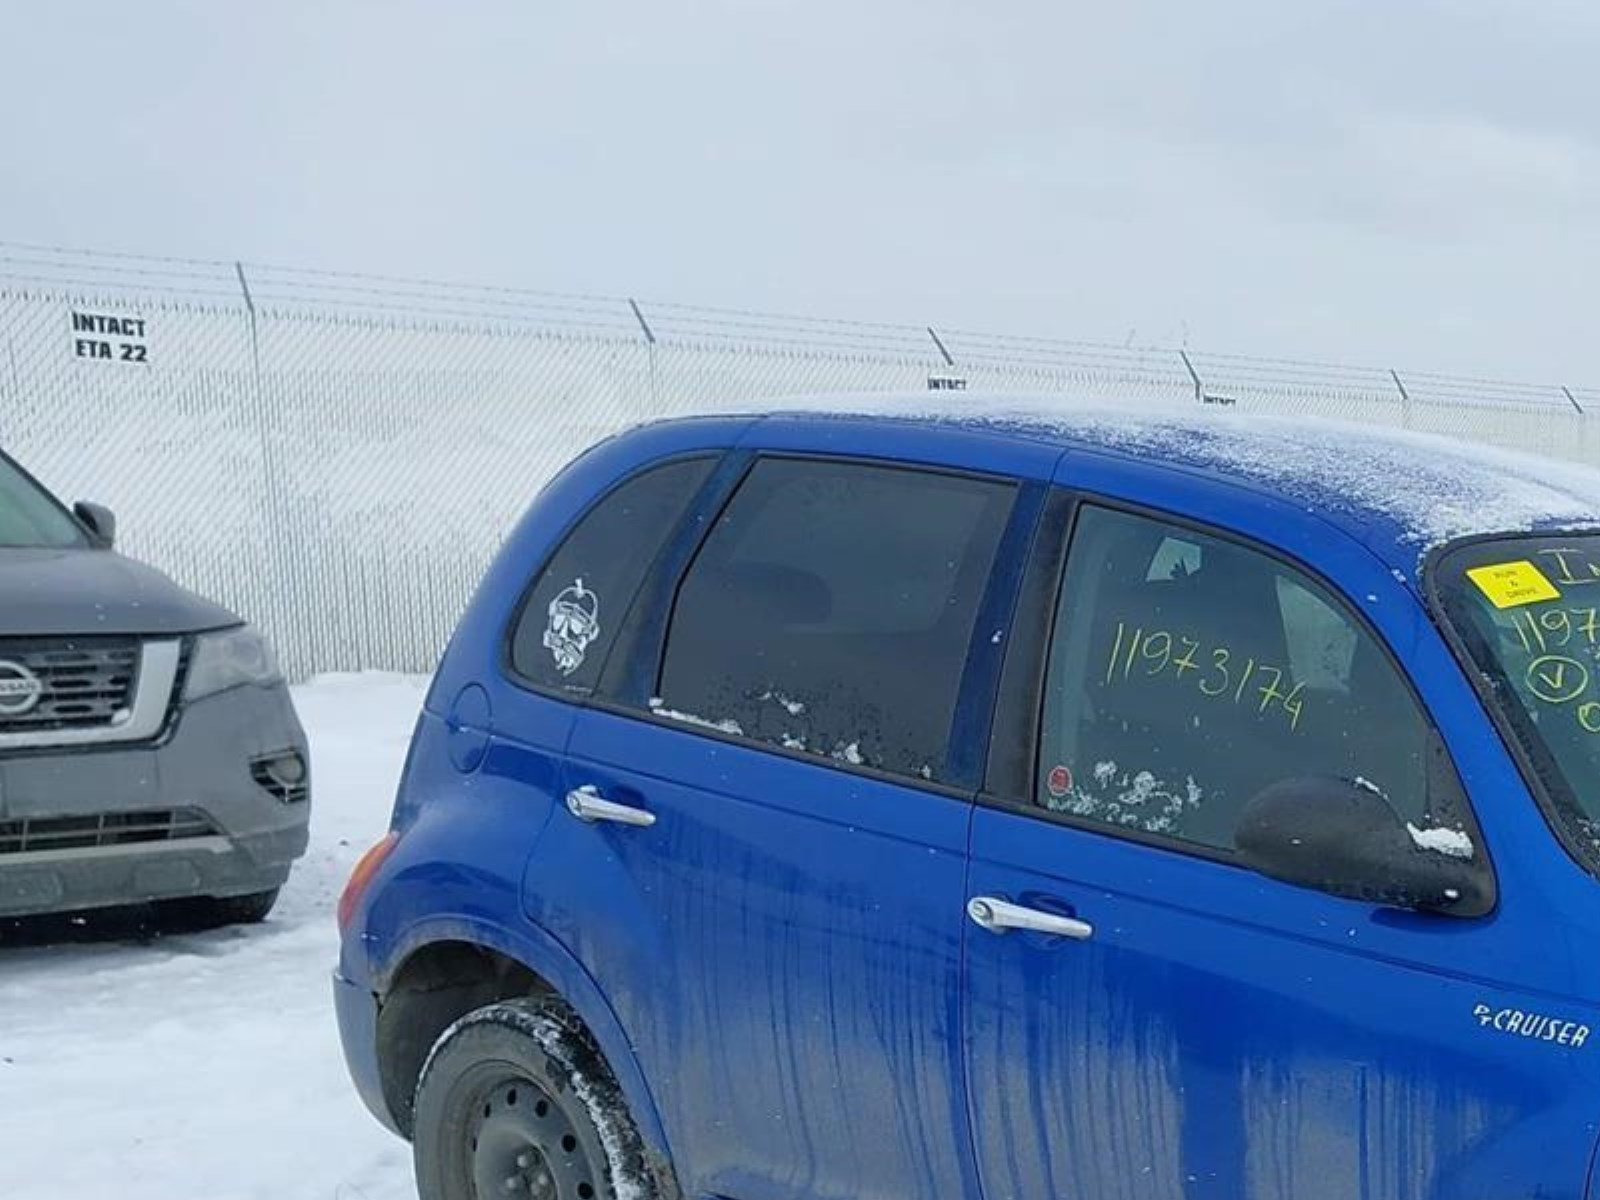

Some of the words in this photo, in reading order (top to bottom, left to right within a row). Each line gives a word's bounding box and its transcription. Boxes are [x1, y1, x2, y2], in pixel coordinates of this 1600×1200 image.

[72, 311, 145, 337] INTACT
[76, 339, 112, 359] ETA
[120, 343, 147, 362] 22
[1107, 622, 1307, 731] 11973174
[1494, 1008, 1590, 1049] CRUISER
